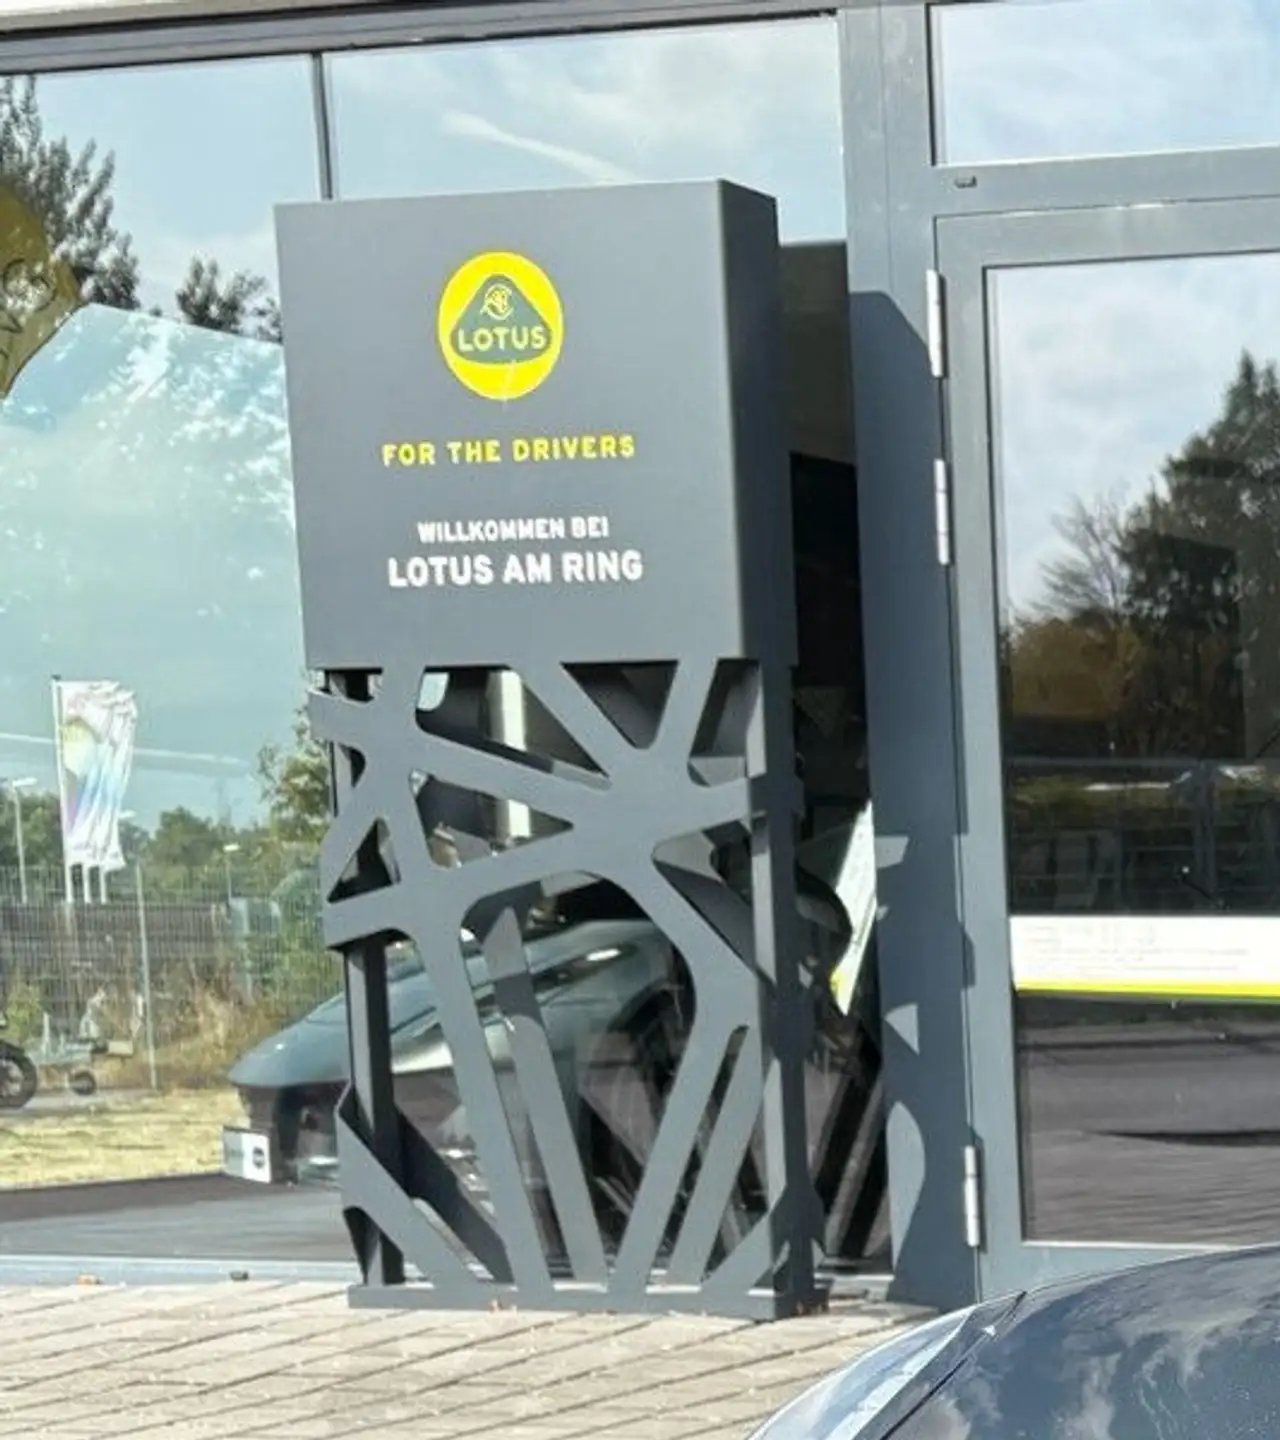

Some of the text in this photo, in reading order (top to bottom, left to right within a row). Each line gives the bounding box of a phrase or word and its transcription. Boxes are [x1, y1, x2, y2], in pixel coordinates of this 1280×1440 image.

[457, 325, 548, 352] LOTUS
[381, 434, 635, 467] FOR THE DRIVERS
[417, 516, 609, 544] WILLKOMMEN BEI
[387, 549, 644, 588] LOTUS AM RING
